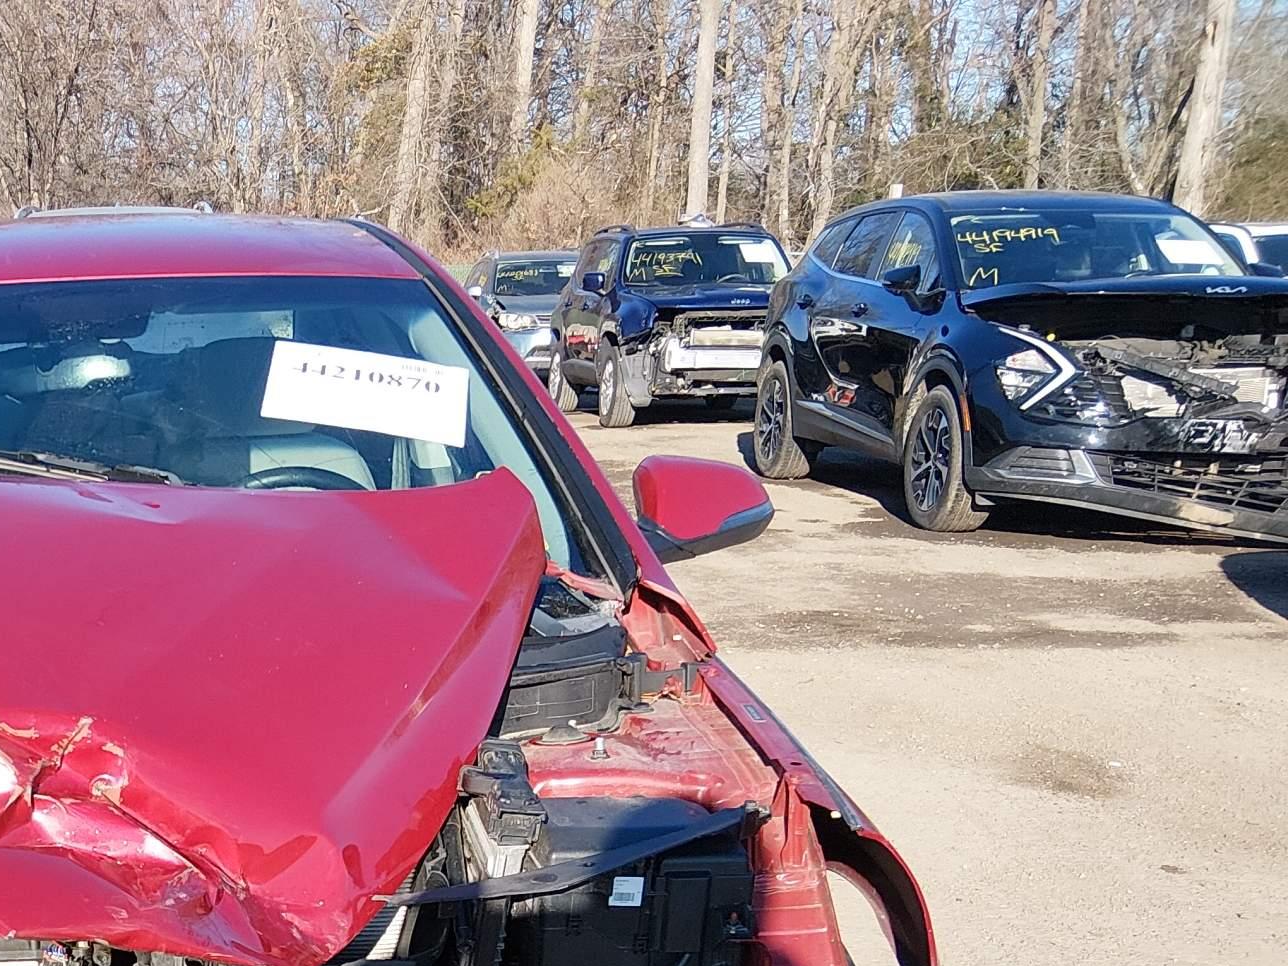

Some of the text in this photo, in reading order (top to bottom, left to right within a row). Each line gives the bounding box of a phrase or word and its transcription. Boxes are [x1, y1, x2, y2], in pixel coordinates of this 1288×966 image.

[628, 267, 646, 282] M
[968, 266, 999, 287] M
[292, 362, 441, 393] 44210870
